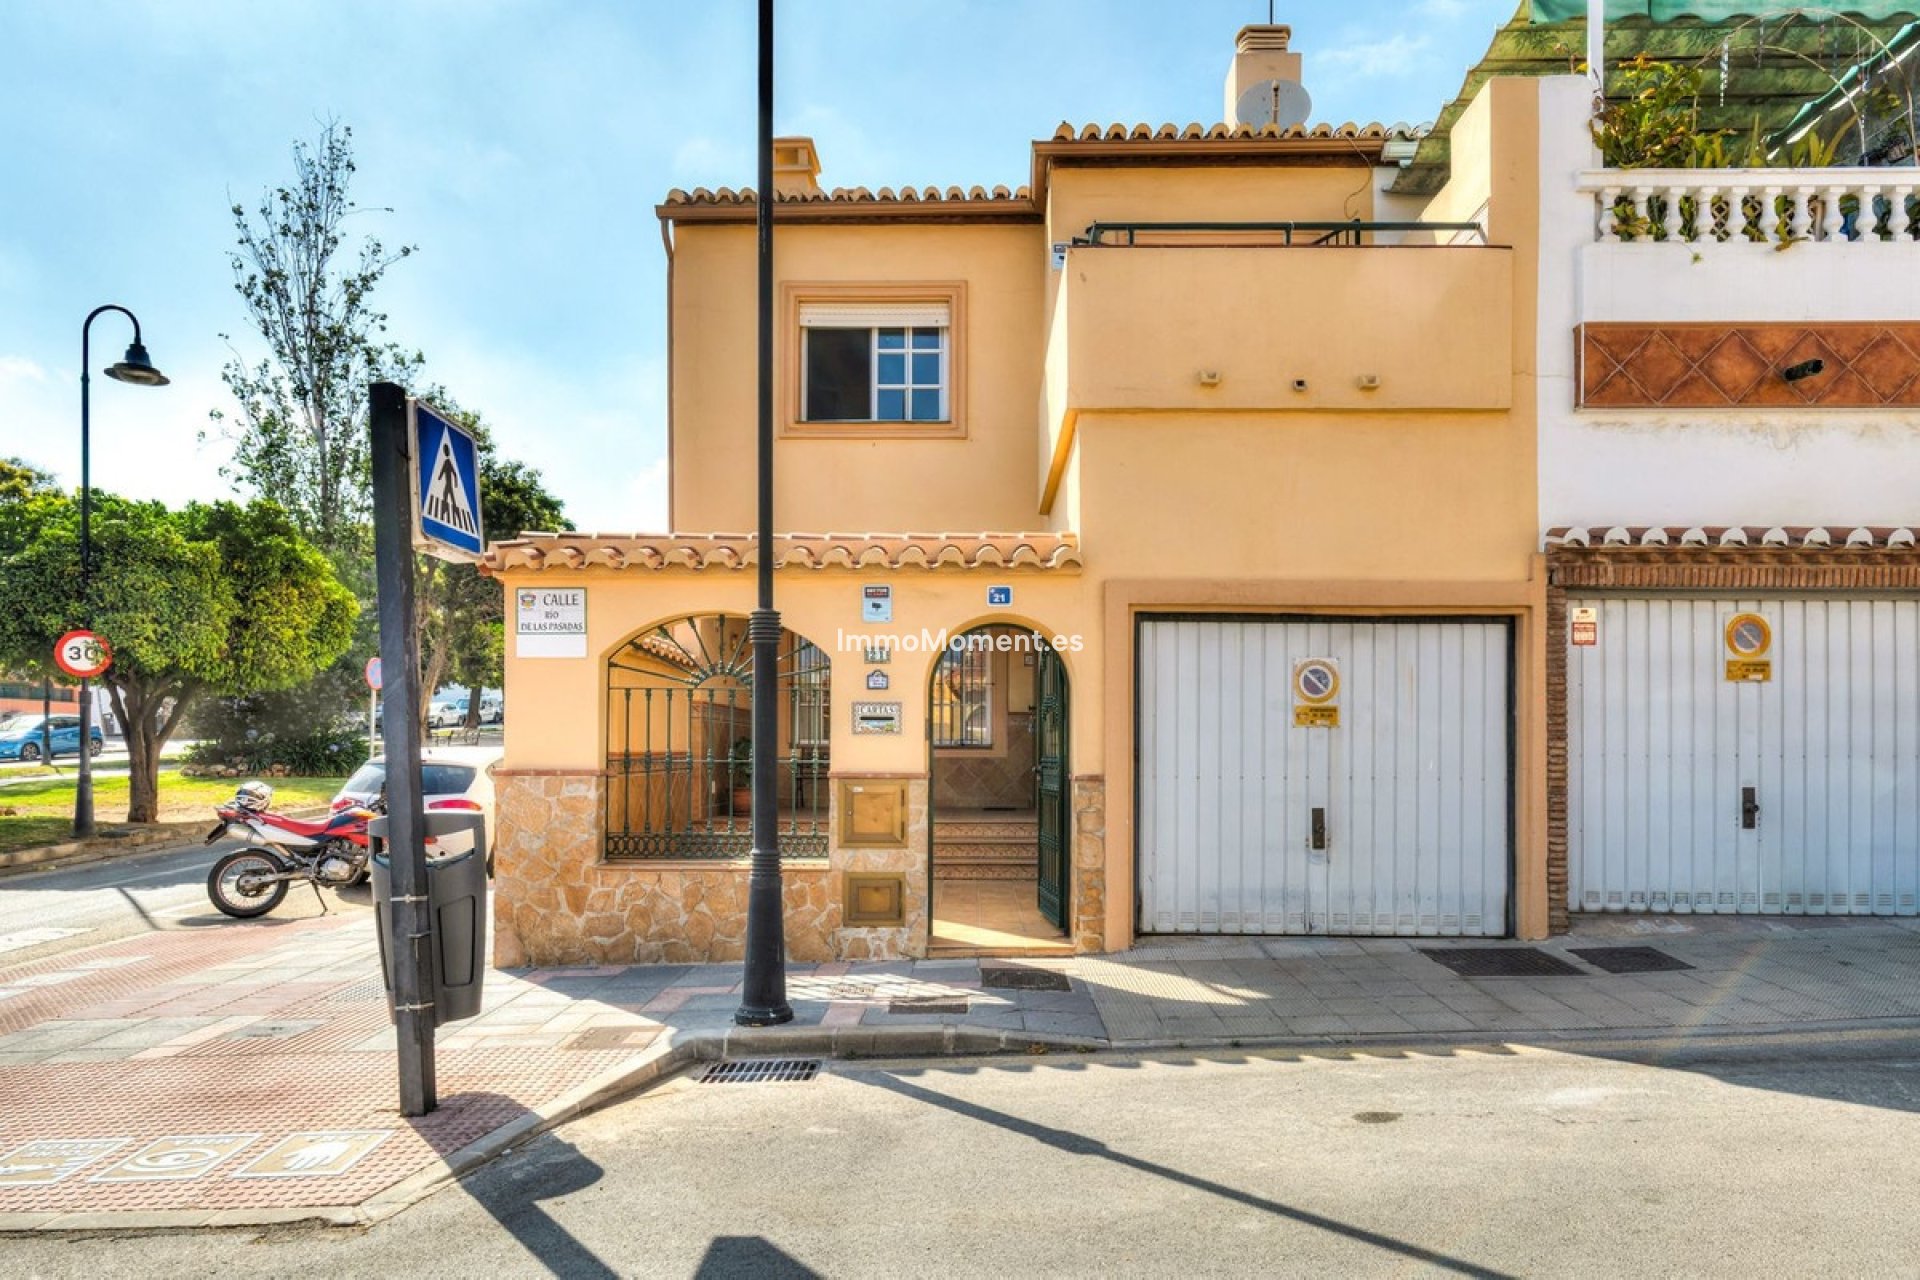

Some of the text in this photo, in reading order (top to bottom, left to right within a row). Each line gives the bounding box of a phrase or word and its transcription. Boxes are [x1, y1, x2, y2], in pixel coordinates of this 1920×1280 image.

[543, 593, 580, 606] CALLE
[993, 593, 1005, 602] 21
[521, 621, 583, 631] DE LAS PASADAS
[69, 646, 98, 661] 30
